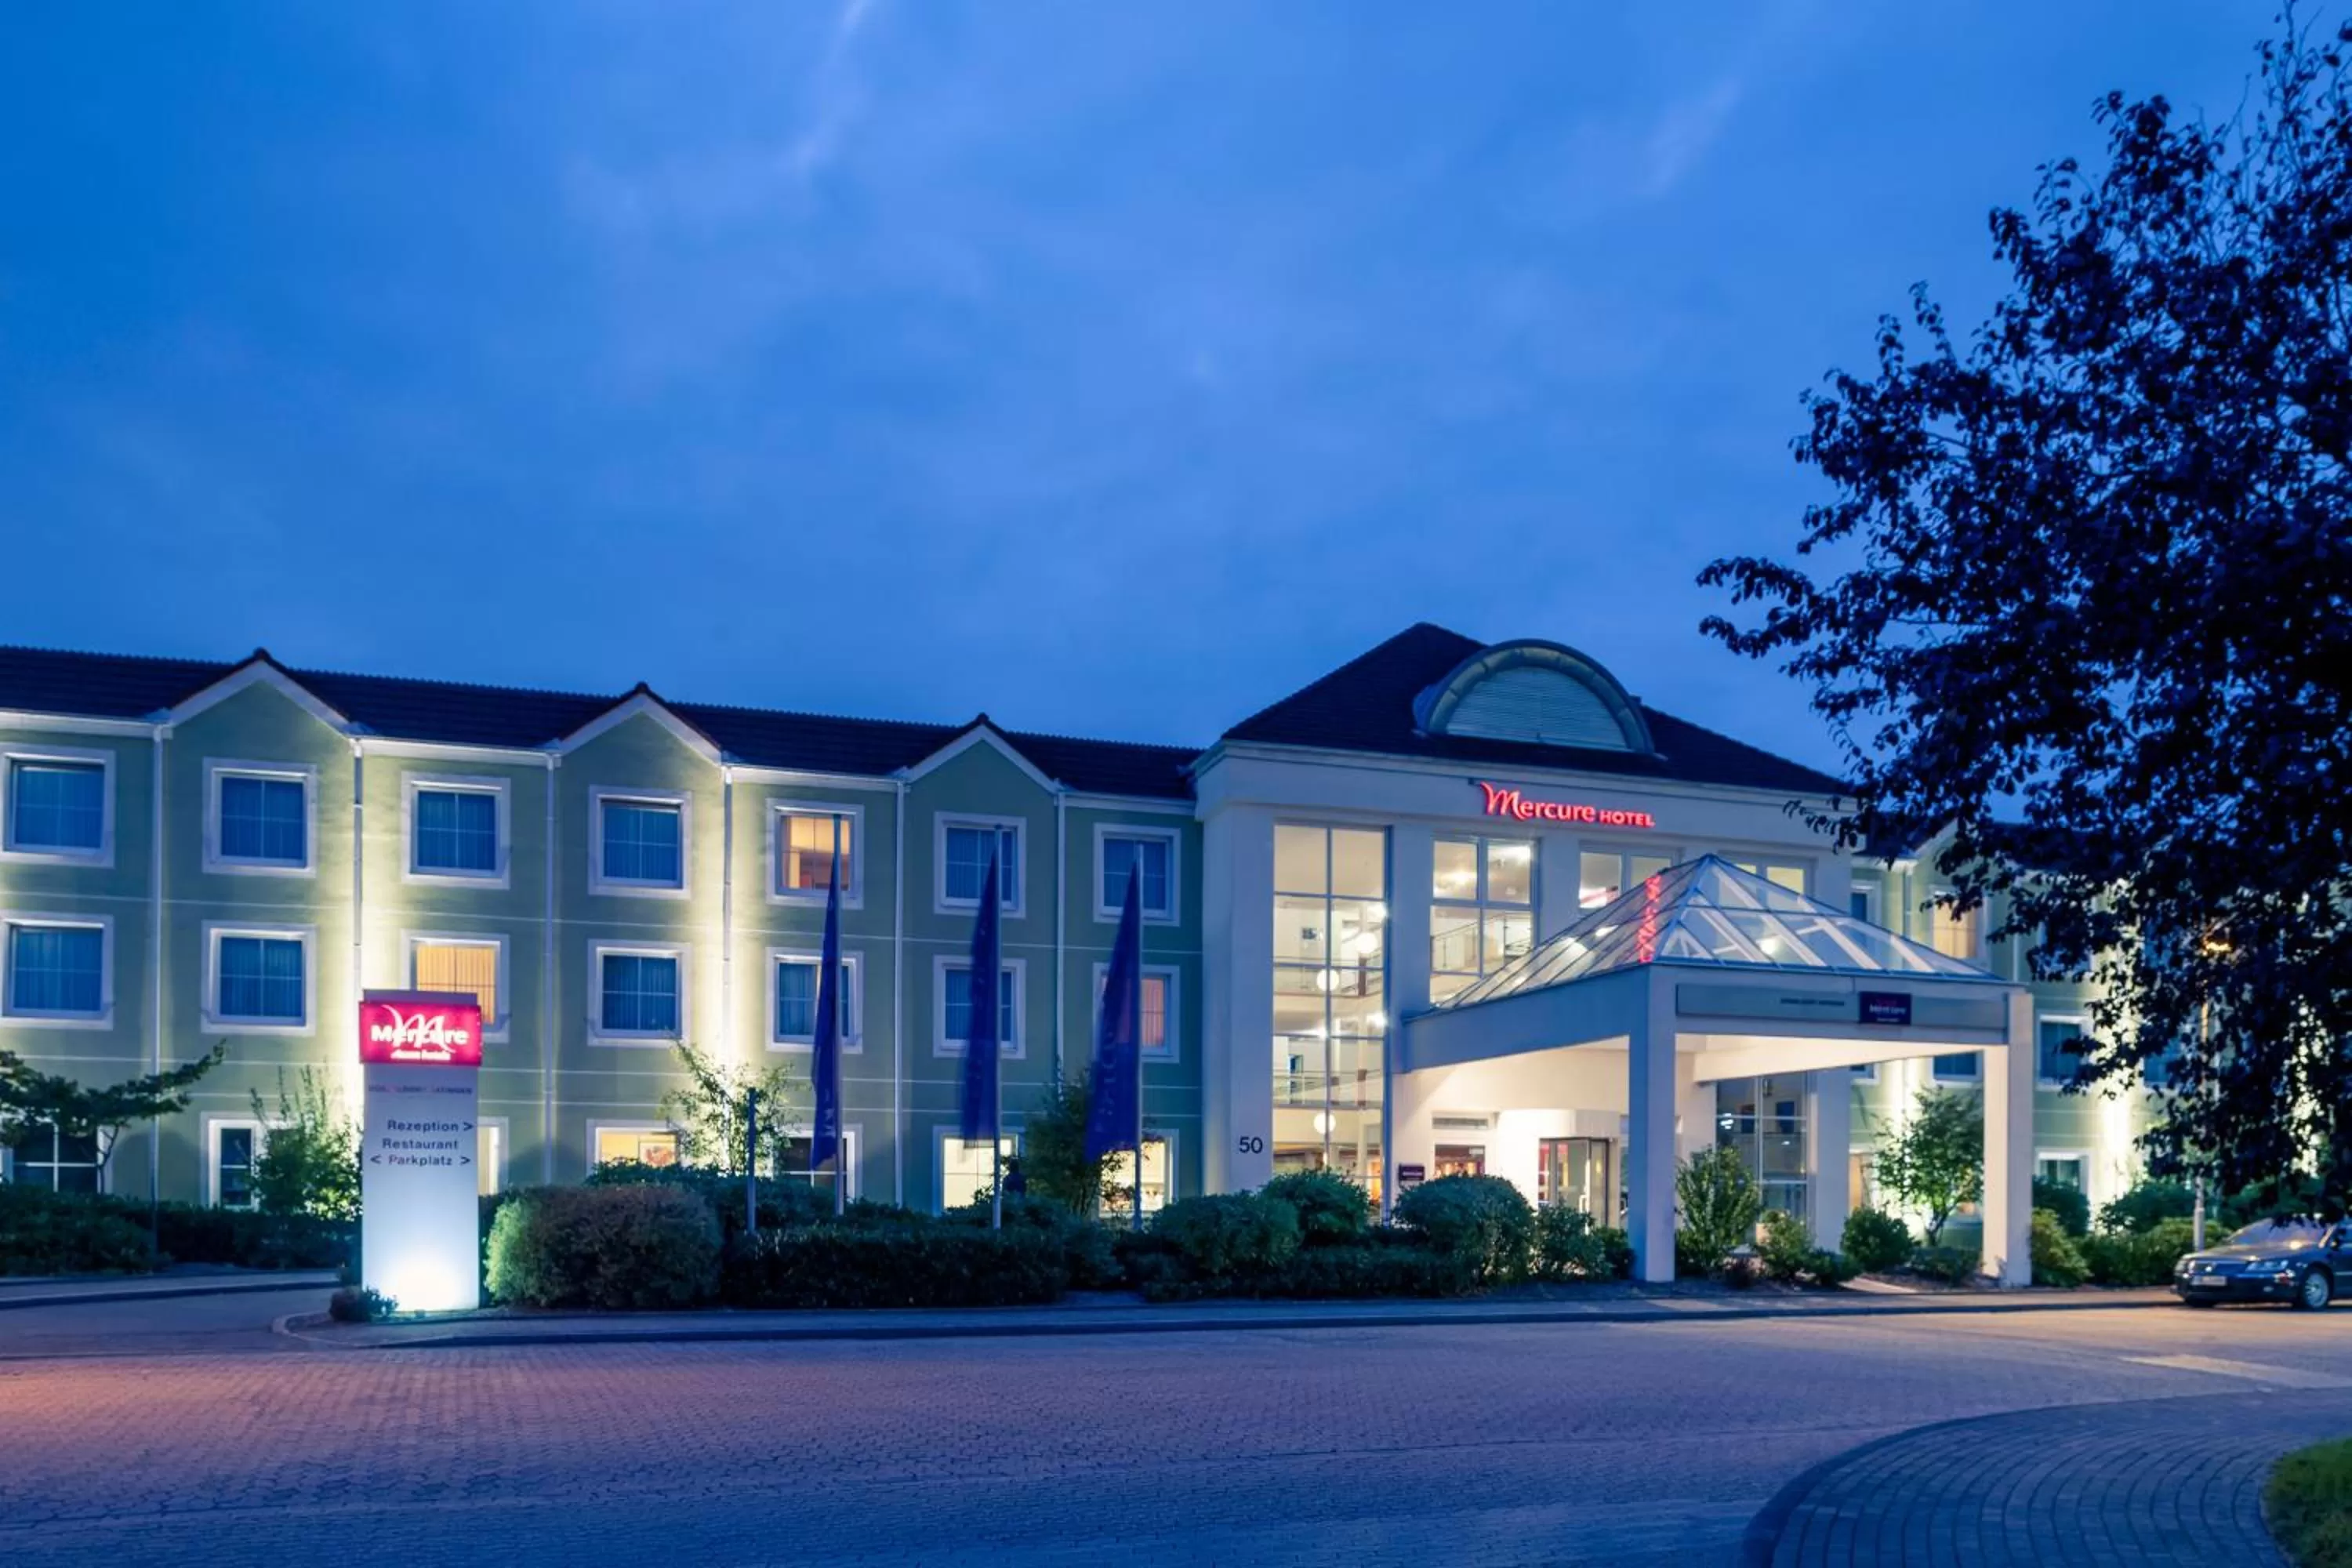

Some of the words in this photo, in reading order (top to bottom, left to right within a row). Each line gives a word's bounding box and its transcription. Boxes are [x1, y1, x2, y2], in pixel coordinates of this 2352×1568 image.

[1480, 782, 1595, 822] Mercure
[1599, 809, 1655, 827] HOTEL
[387, 1120, 459, 1134] Rezeption
[382, 1138, 459, 1149] Restaurant
[1238, 1137, 1264, 1153] 50
[388, 1155, 453, 1167] Parkplatz
